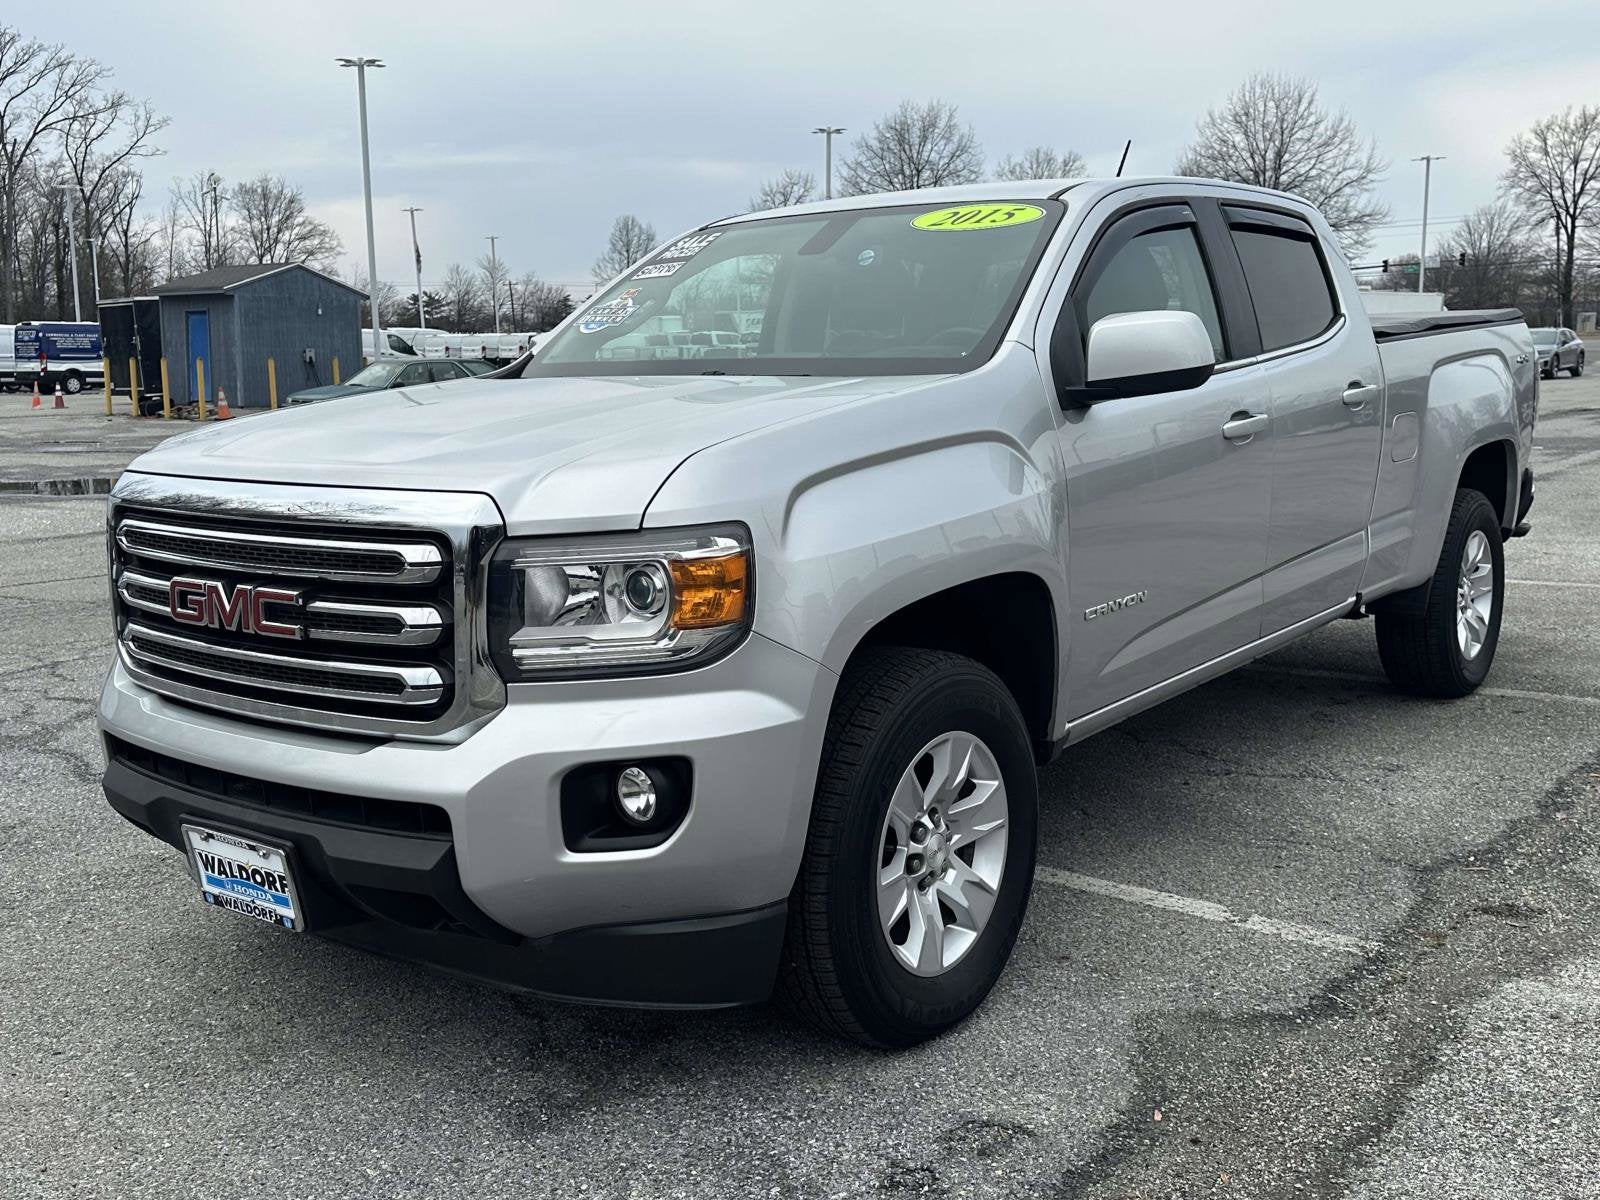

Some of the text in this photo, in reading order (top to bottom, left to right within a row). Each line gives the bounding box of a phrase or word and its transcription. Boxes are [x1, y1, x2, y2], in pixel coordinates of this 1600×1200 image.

[927, 207, 1026, 227] 2015
[670, 232, 722, 250] SALE
[169, 576, 303, 641] GMC
[1083, 590, 1148, 621] CANYON
[214, 834, 250, 849] HONDA
[198, 851, 289, 894] WALDORF
[233, 884, 275, 902] HONDA
[221, 895, 276, 922] WALDORF
